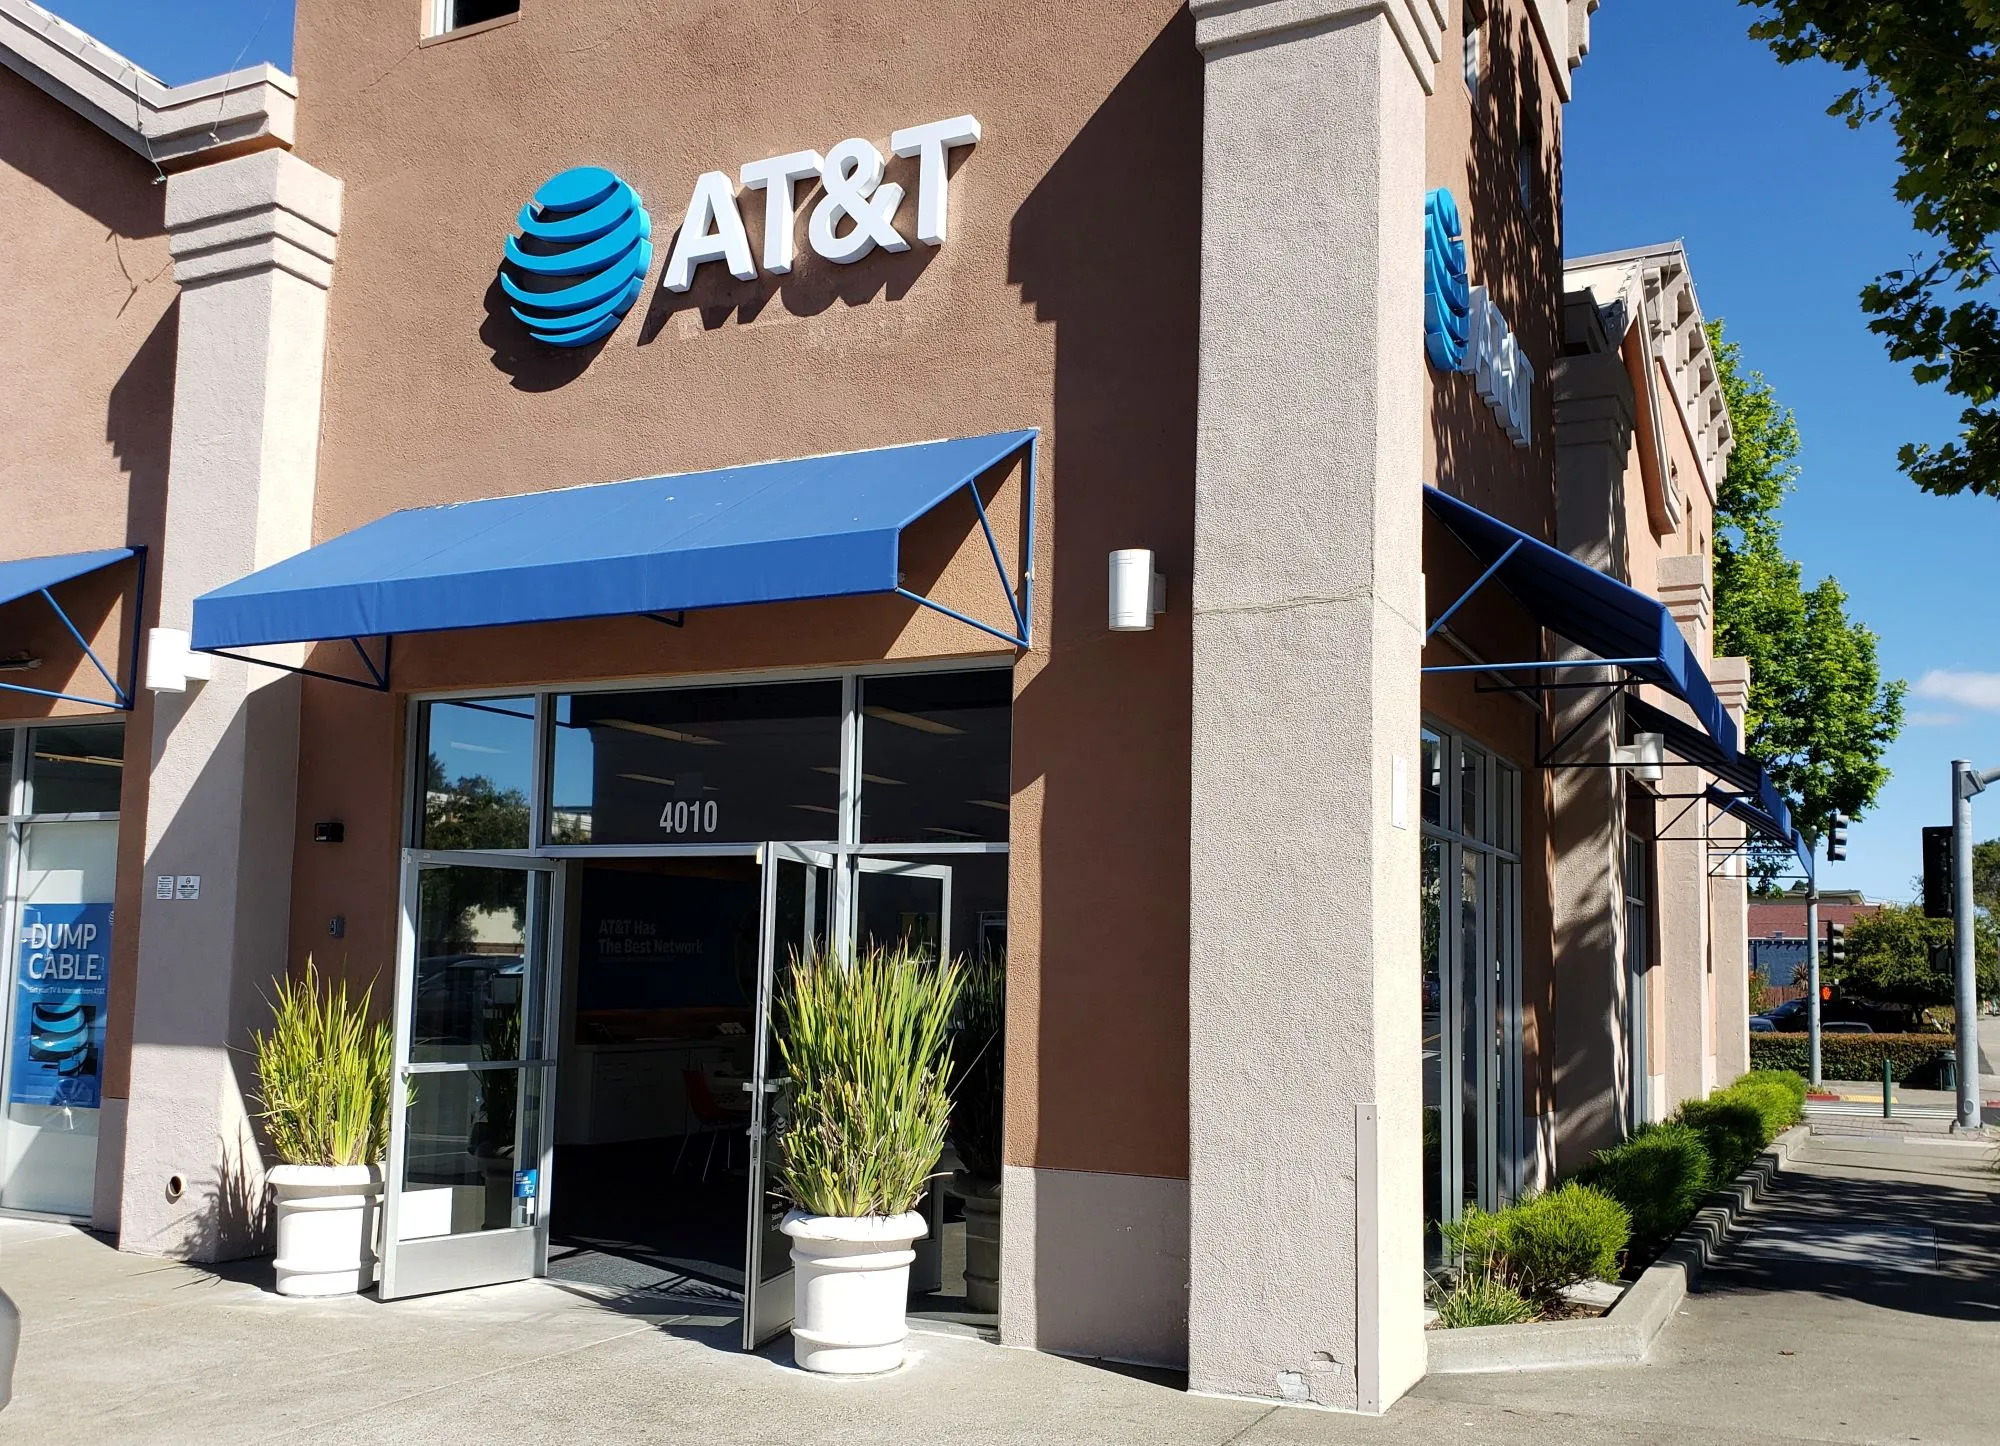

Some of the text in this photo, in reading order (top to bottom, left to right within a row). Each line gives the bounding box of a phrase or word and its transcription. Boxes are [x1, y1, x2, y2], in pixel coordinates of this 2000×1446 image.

[662, 114, 982, 293] AT&T
[659, 800, 718, 833] 4010
[30, 923, 97, 950] DUMP
[598, 918, 657, 936] AT&T Has
[598, 938, 704, 955] The Best Network
[29, 952, 102, 981] CABLE.
